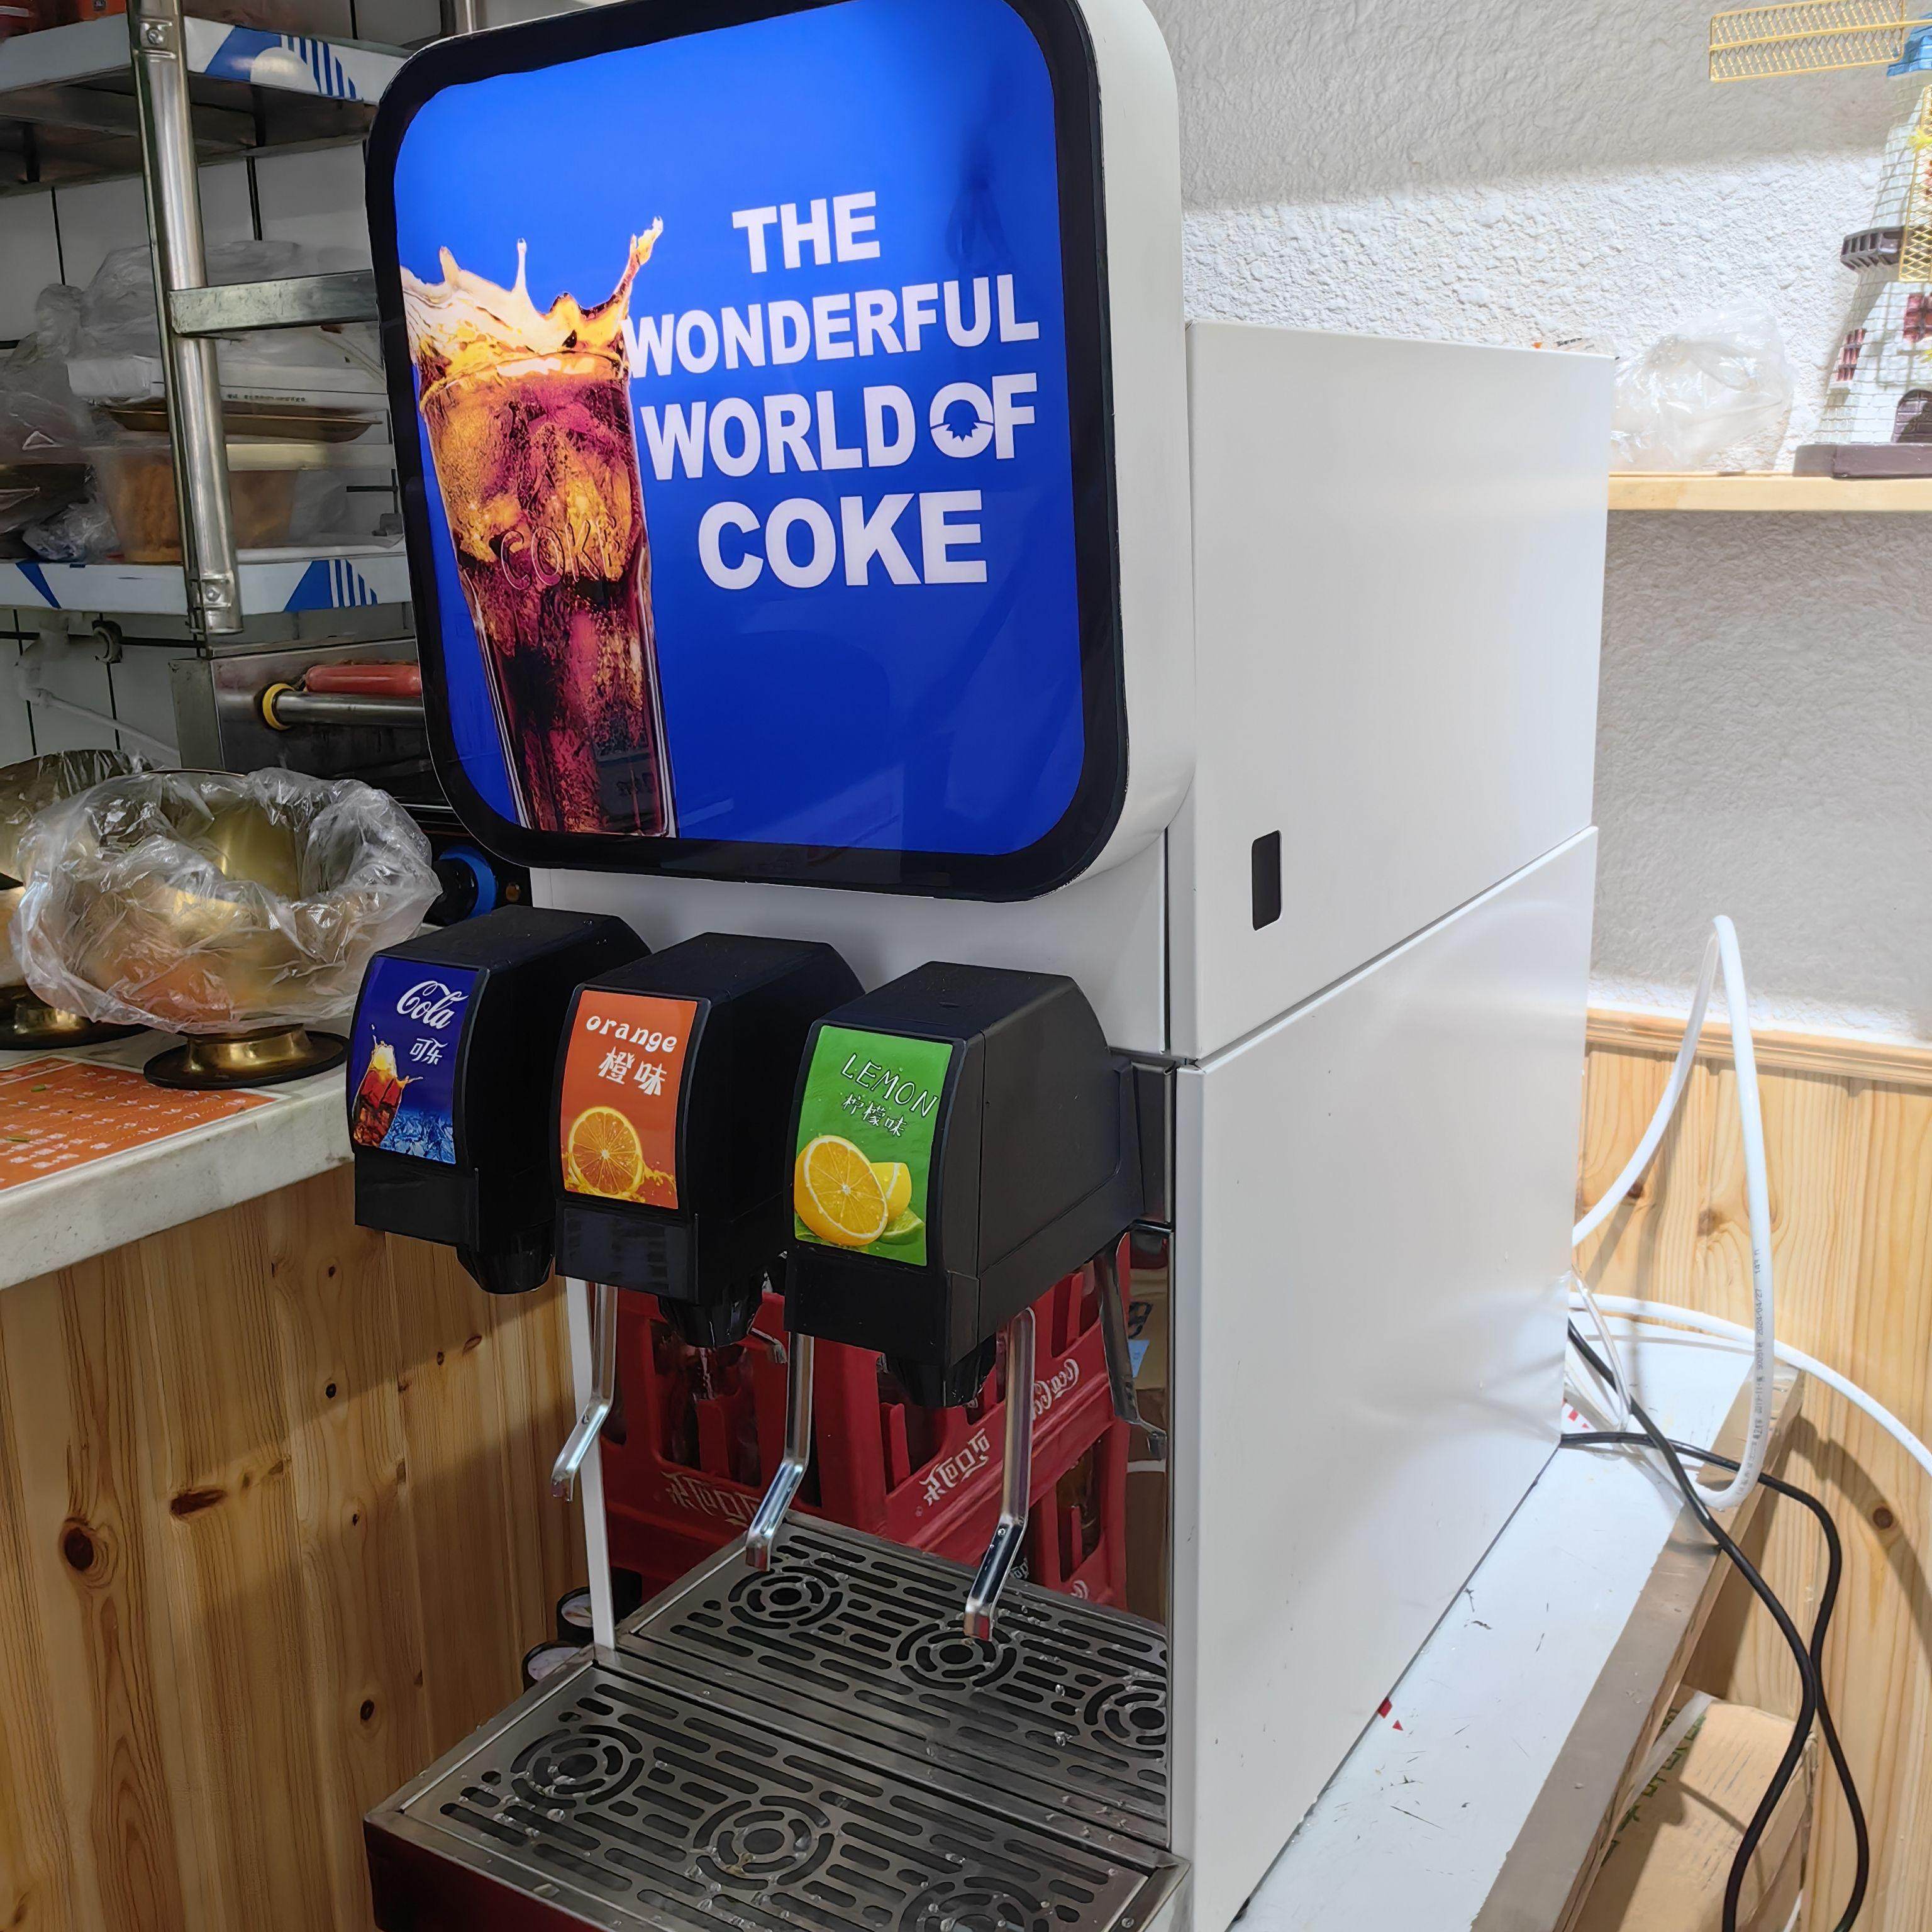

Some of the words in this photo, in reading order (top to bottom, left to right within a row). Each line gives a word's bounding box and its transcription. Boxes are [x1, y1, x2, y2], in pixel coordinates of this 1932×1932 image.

[732, 191, 880, 273] THE
[621, 274, 1039, 379] WONDERFUL
[640, 385, 916, 480] WORLD
[930, 372, 1038, 459] OF
[697, 489, 987, 589] COKE
[397, 980, 469, 1030] Cola
[409, 1038, 448, 1065] 可乐
[586, 1016, 677, 1053] orange
[598, 1046, 667, 1096] 橙味
[841, 1052, 939, 1118] LEMON
[842, 1093, 908, 1137] 柠檬味
